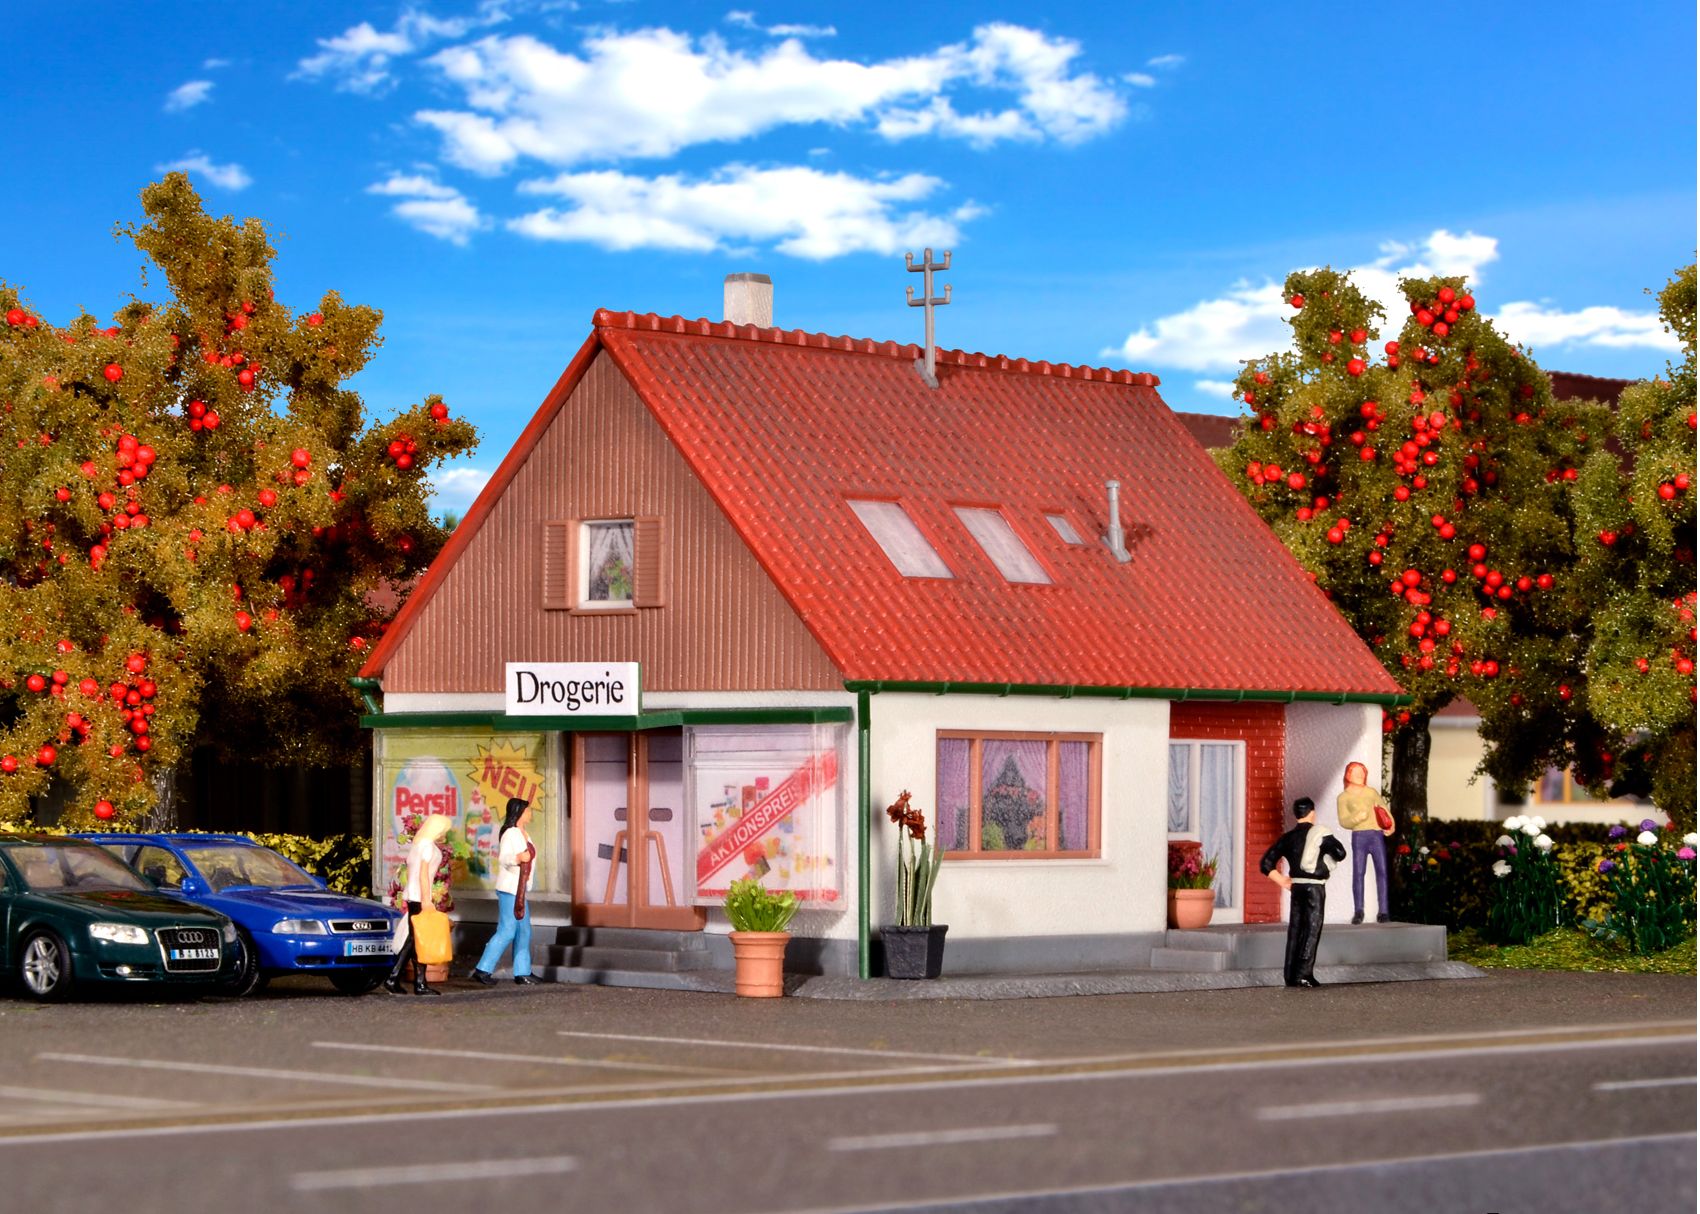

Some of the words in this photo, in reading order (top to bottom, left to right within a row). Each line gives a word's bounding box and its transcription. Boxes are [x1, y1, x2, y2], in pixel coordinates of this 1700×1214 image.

[515, 671, 624, 711] Drogerie
[395, 784, 457, 817] Persil
[352, 944, 363, 953] HB
[365, 944, 376, 953] KB
